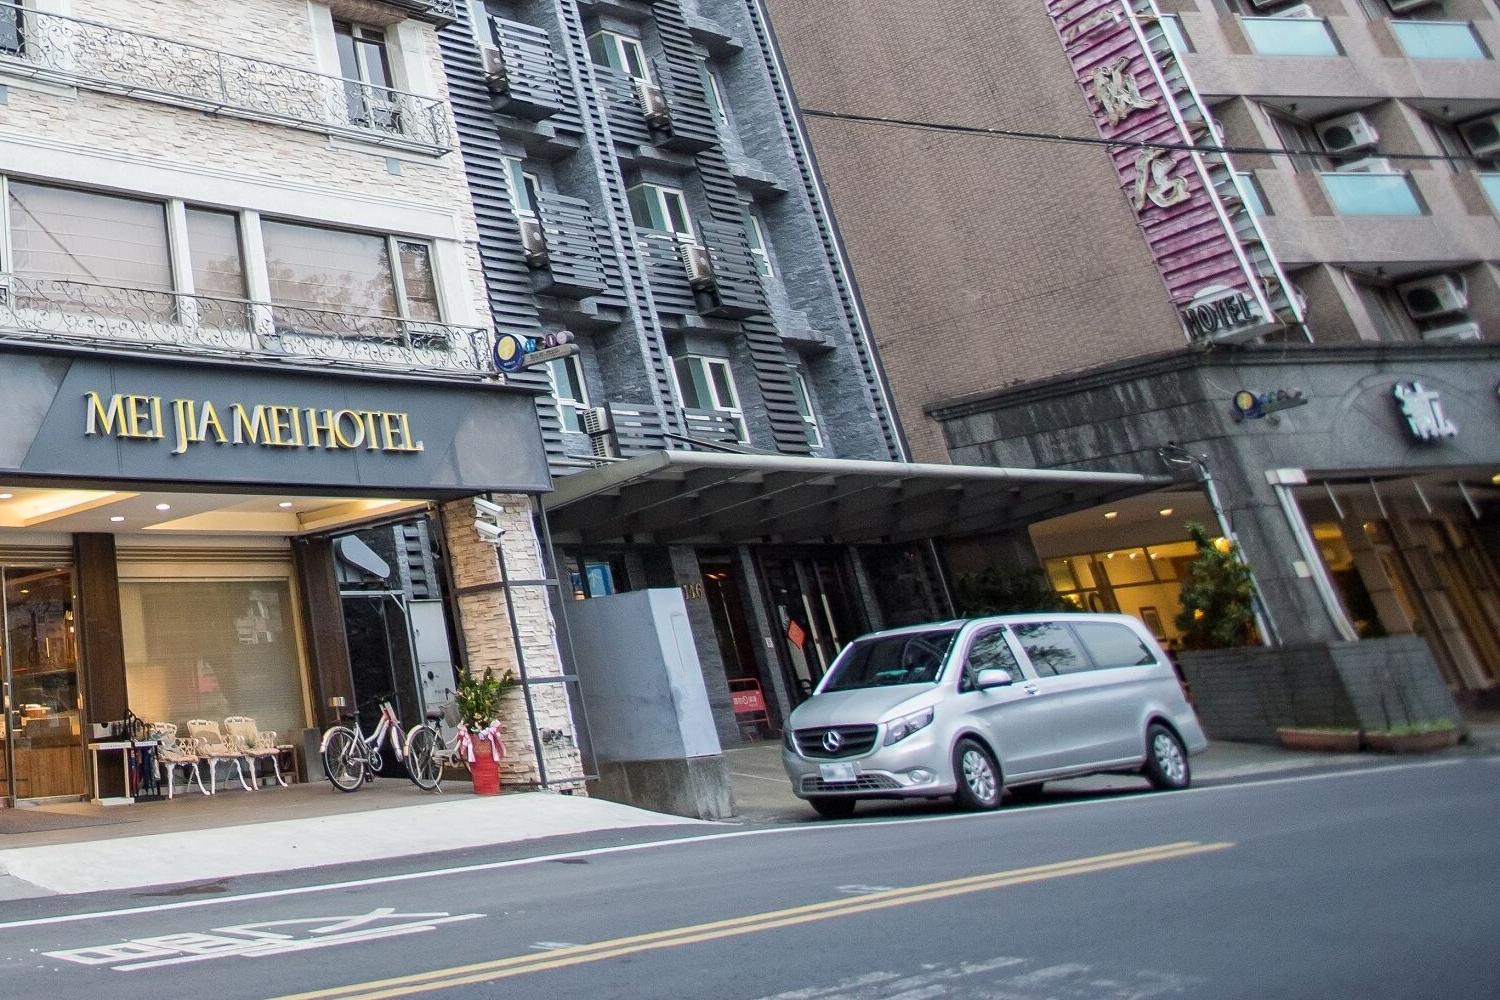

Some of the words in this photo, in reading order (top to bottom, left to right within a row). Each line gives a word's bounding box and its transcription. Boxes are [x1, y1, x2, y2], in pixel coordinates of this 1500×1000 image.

[1180, 291, 1259, 339] HOTEL
[83, 390, 165, 440] MEI
[170, 399, 229, 455] JIA
[228, 402, 304, 447] MEI
[304, 407, 425, 453] HOTEL
[682, 583, 702, 600] 146
